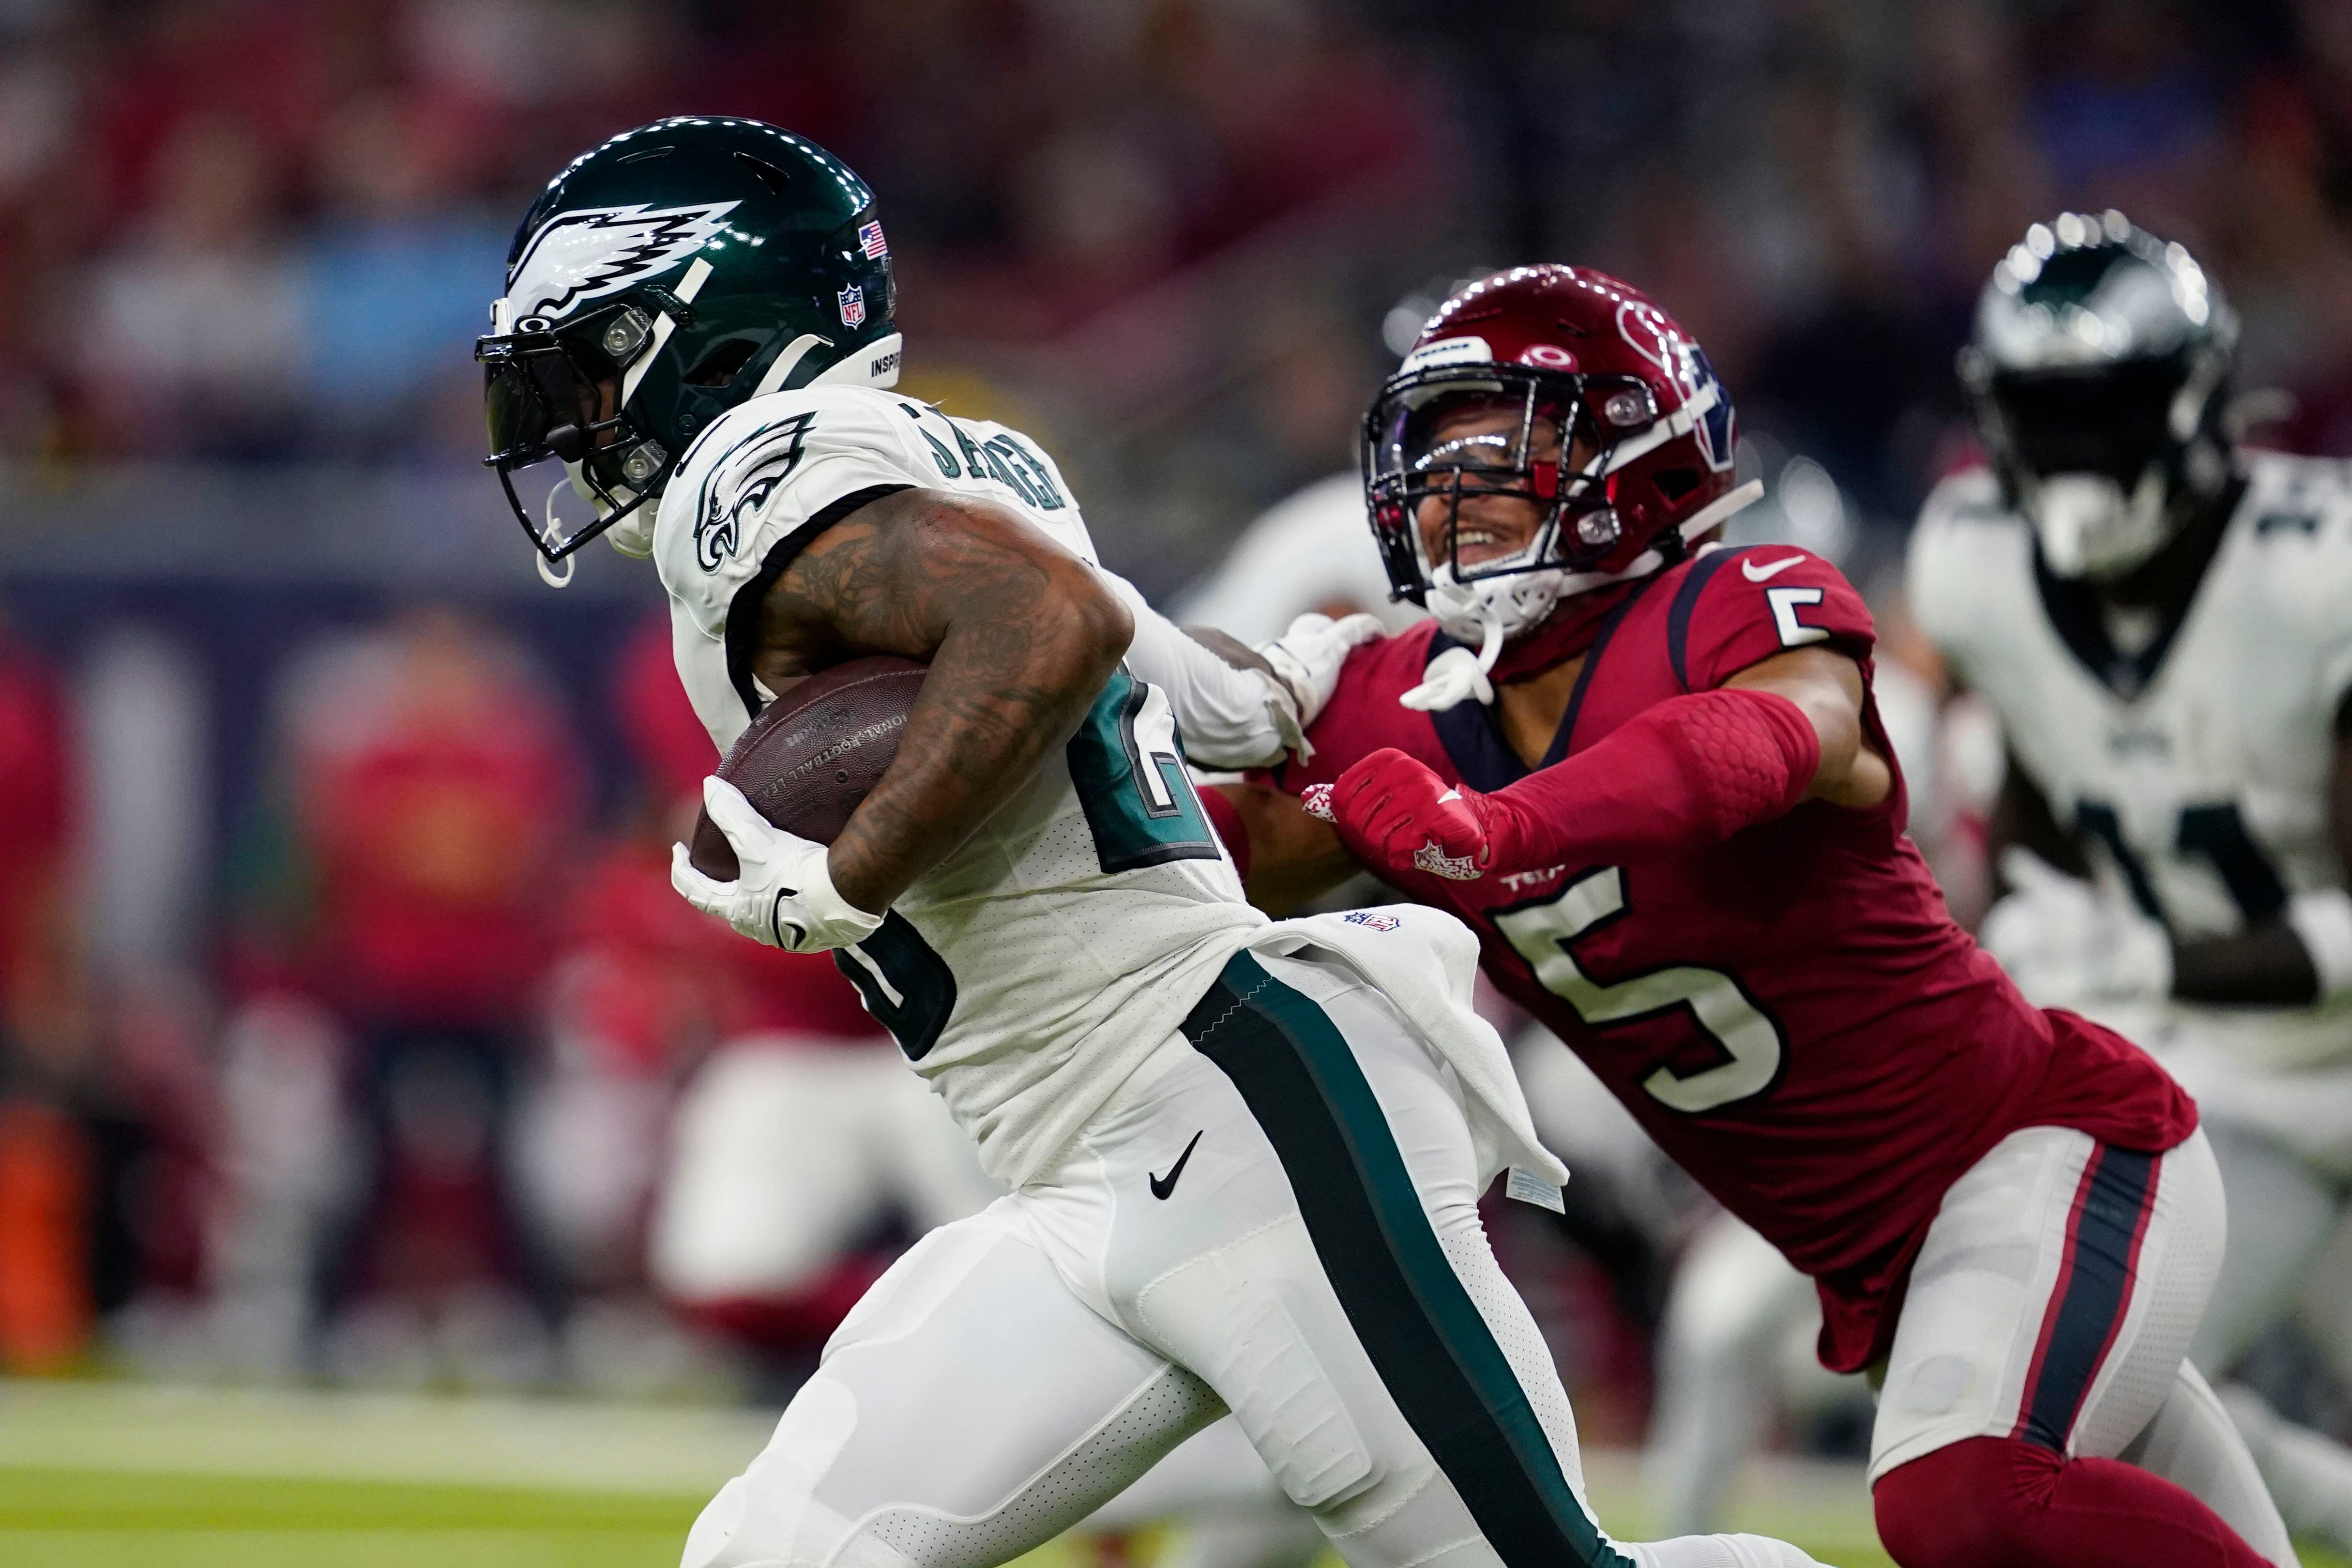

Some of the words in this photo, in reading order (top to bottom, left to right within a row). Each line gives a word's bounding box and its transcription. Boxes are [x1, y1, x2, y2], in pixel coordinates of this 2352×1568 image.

[844, 303, 863, 322] NFL
[789, 734, 861, 780] FOOTBALL
[1066, 661, 1222, 874] 2
[1486, 865, 1786, 1115] 5
